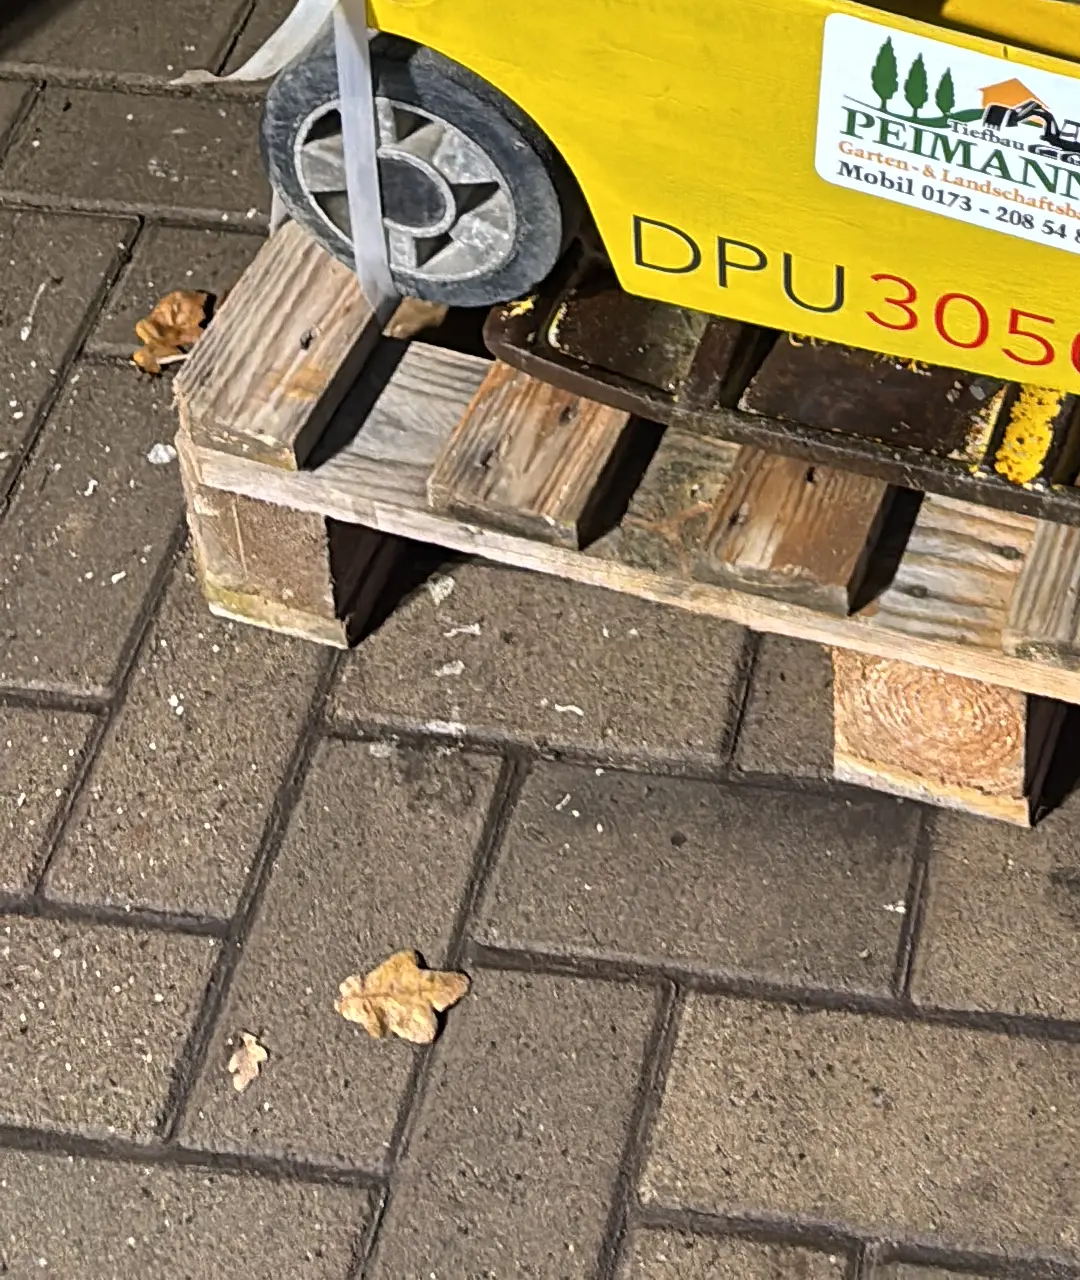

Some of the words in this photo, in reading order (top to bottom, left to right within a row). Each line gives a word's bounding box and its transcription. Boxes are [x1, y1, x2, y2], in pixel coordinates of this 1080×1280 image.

[948, 119, 1025, 151] Tiefbau
[922, 163, 937, 179] &
[836, 159, 915, 196] Mobil
[922, 184, 972, 212] 0173
[995, 206, 1034, 229] 208
[1041, 219, 1067, 239] 54
